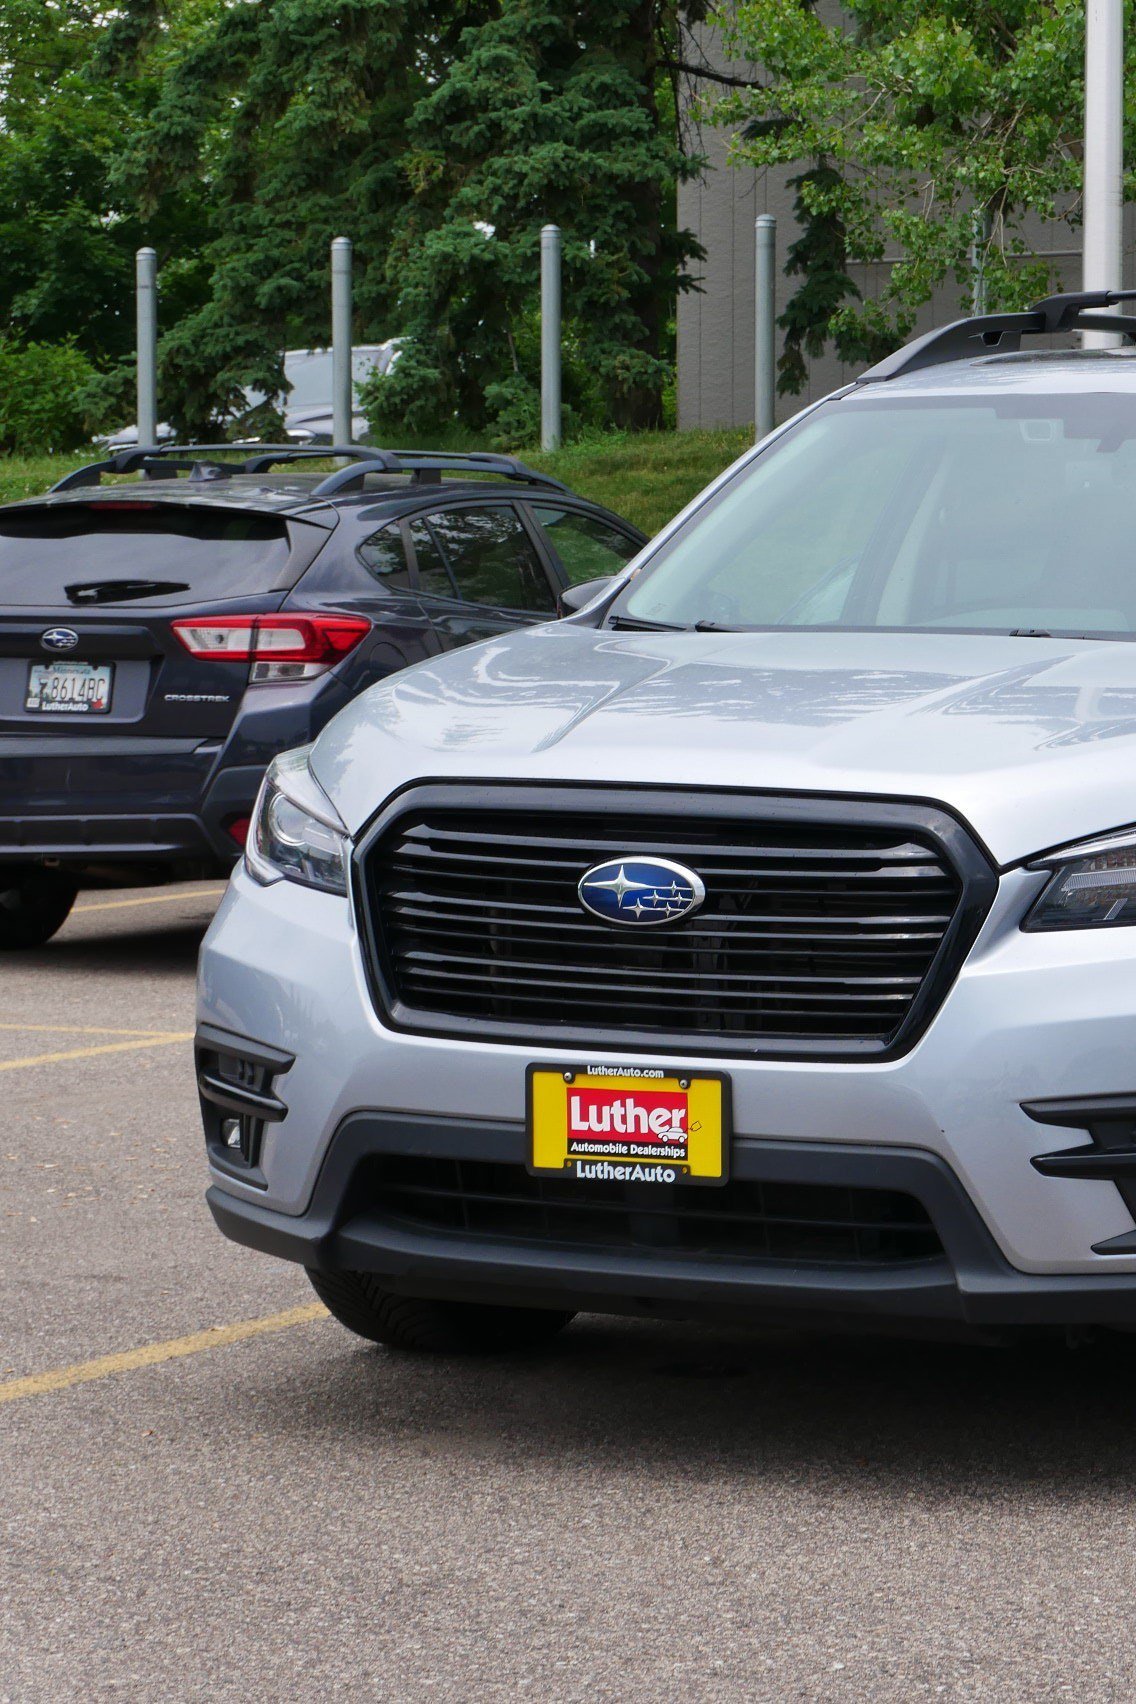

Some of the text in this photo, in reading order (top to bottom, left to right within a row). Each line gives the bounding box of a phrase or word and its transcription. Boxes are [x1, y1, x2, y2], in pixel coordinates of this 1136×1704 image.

[41, 701, 89, 711] LutherAuto
[164, 694, 230, 702] CROSSTREK
[587, 1065, 664, 1079] LutherAuto.com
[570, 1095, 686, 1135] Luther
[570, 1141, 686, 1159] Automobile Dealerships
[576, 1160, 676, 1183] LutherAuto
